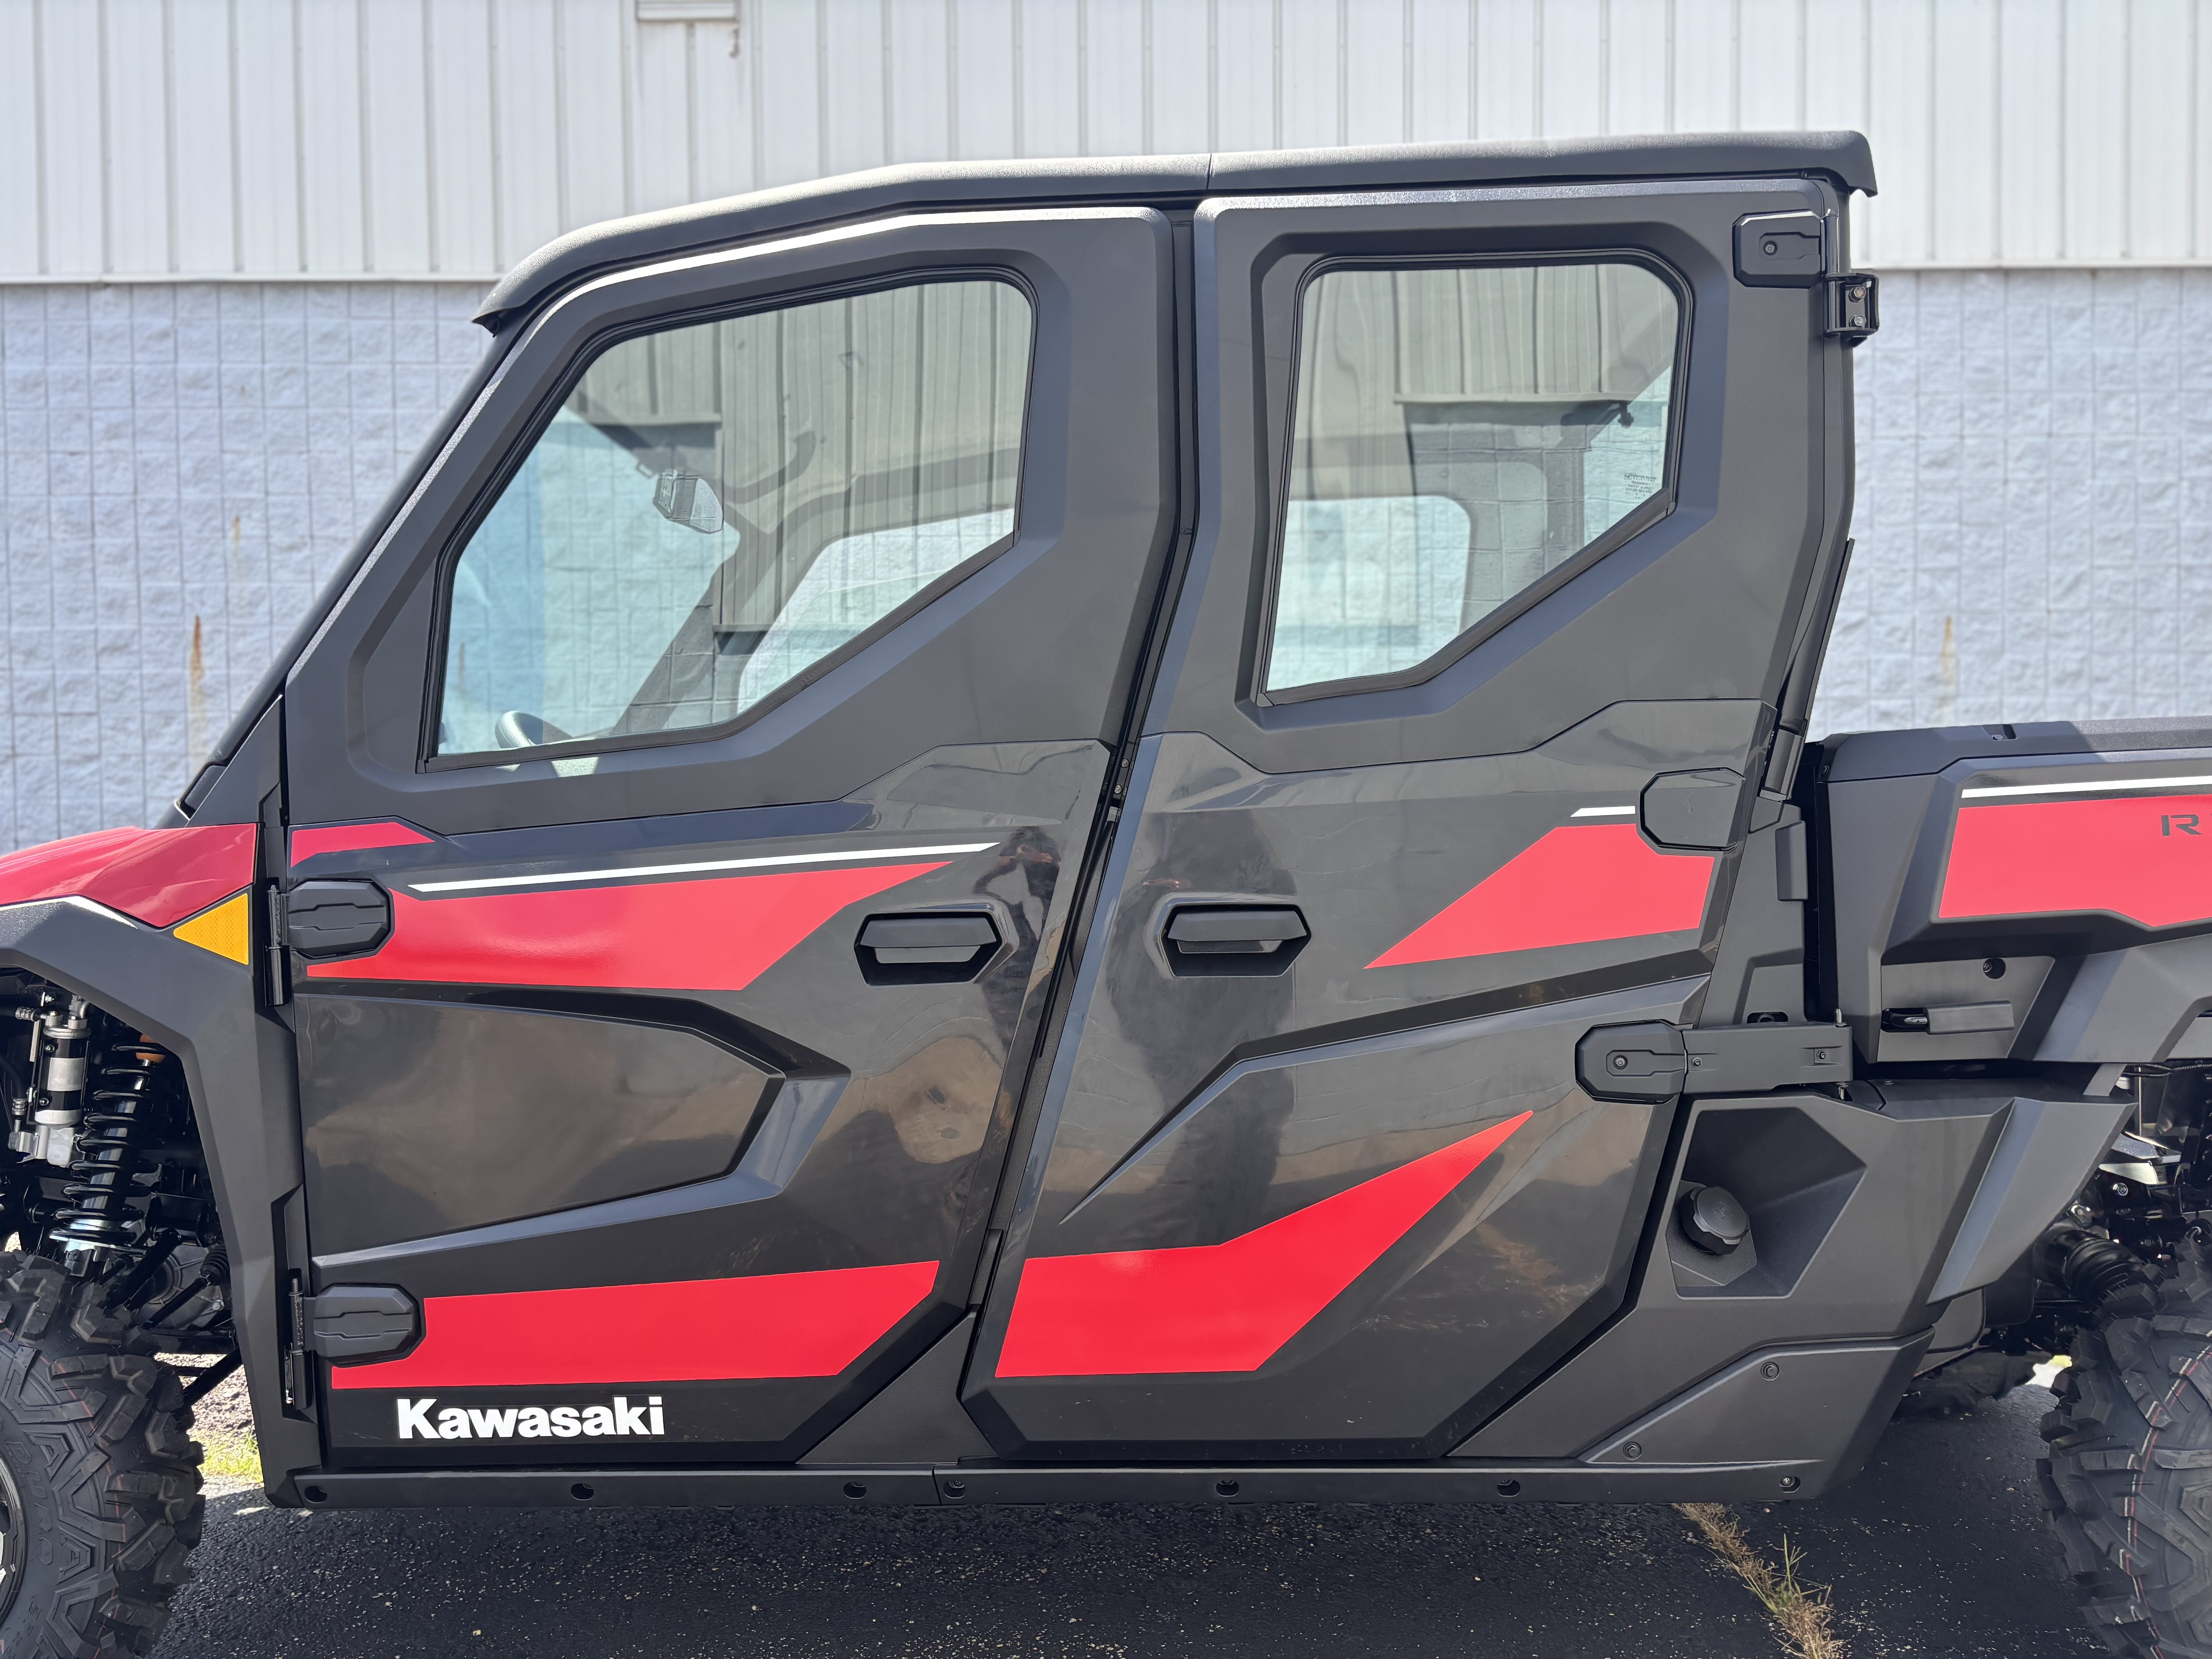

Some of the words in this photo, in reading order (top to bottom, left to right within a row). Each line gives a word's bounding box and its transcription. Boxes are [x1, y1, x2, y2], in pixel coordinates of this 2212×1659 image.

[2161, 814, 2212, 836] R
[397, 1396, 665, 1439] Kawasaki
[6, 1441, 53, 1565] DURO
